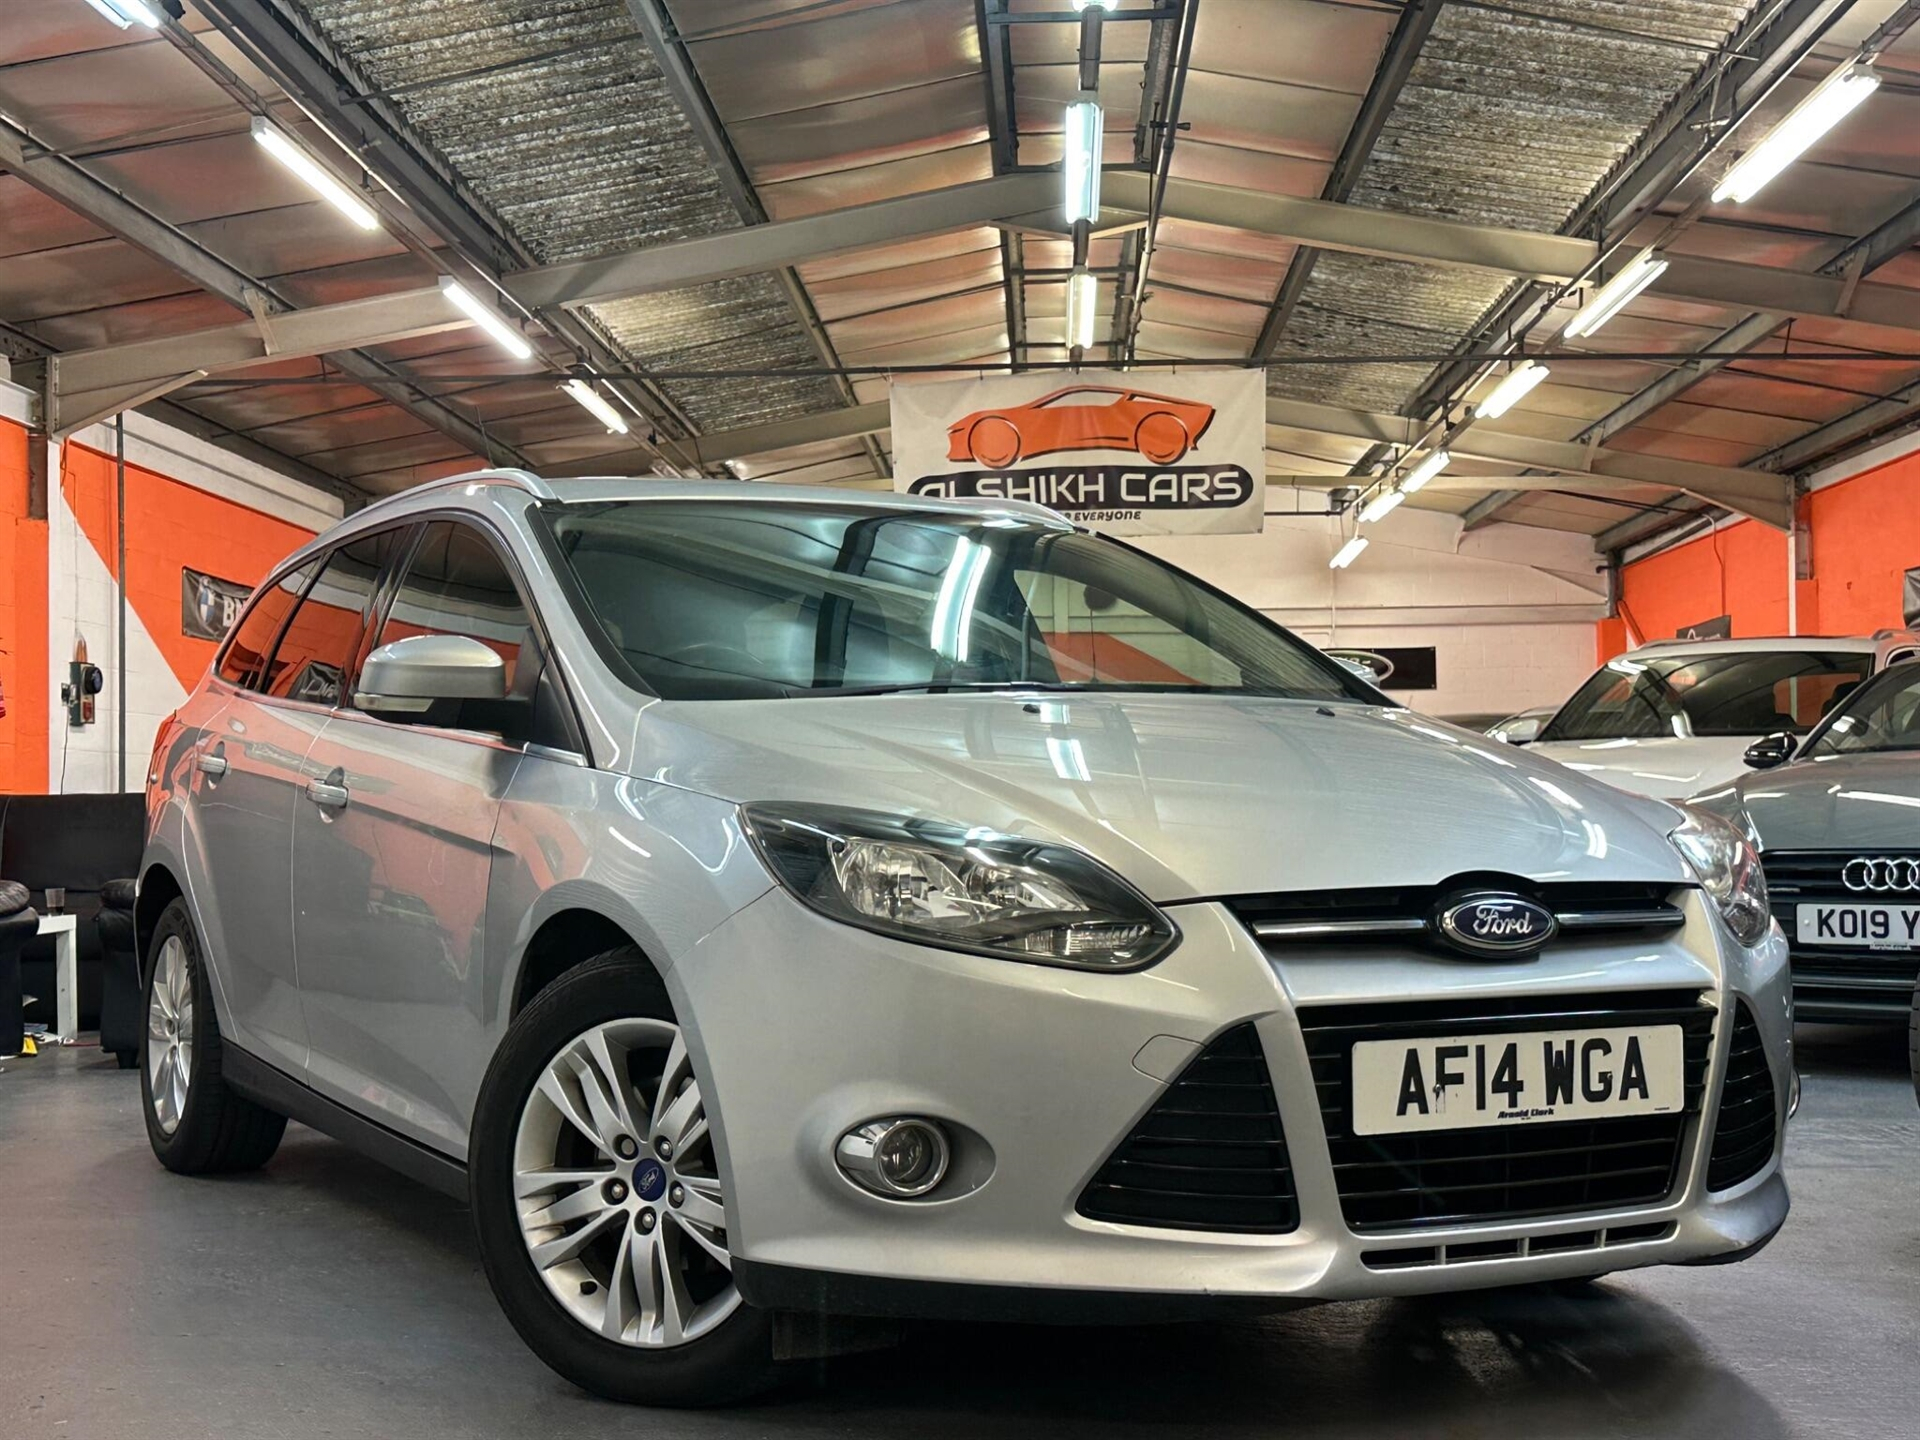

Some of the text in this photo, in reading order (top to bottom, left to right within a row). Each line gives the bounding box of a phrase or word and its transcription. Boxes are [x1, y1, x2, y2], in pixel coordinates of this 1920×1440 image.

[1120, 471, 1243, 503] CARS
[1074, 511, 1142, 521] EVERYONE
[1472, 904, 1533, 935] Ford
[1817, 909, 1890, 939] KO19
[1396, 1035, 1650, 1116] AF14 WGA
